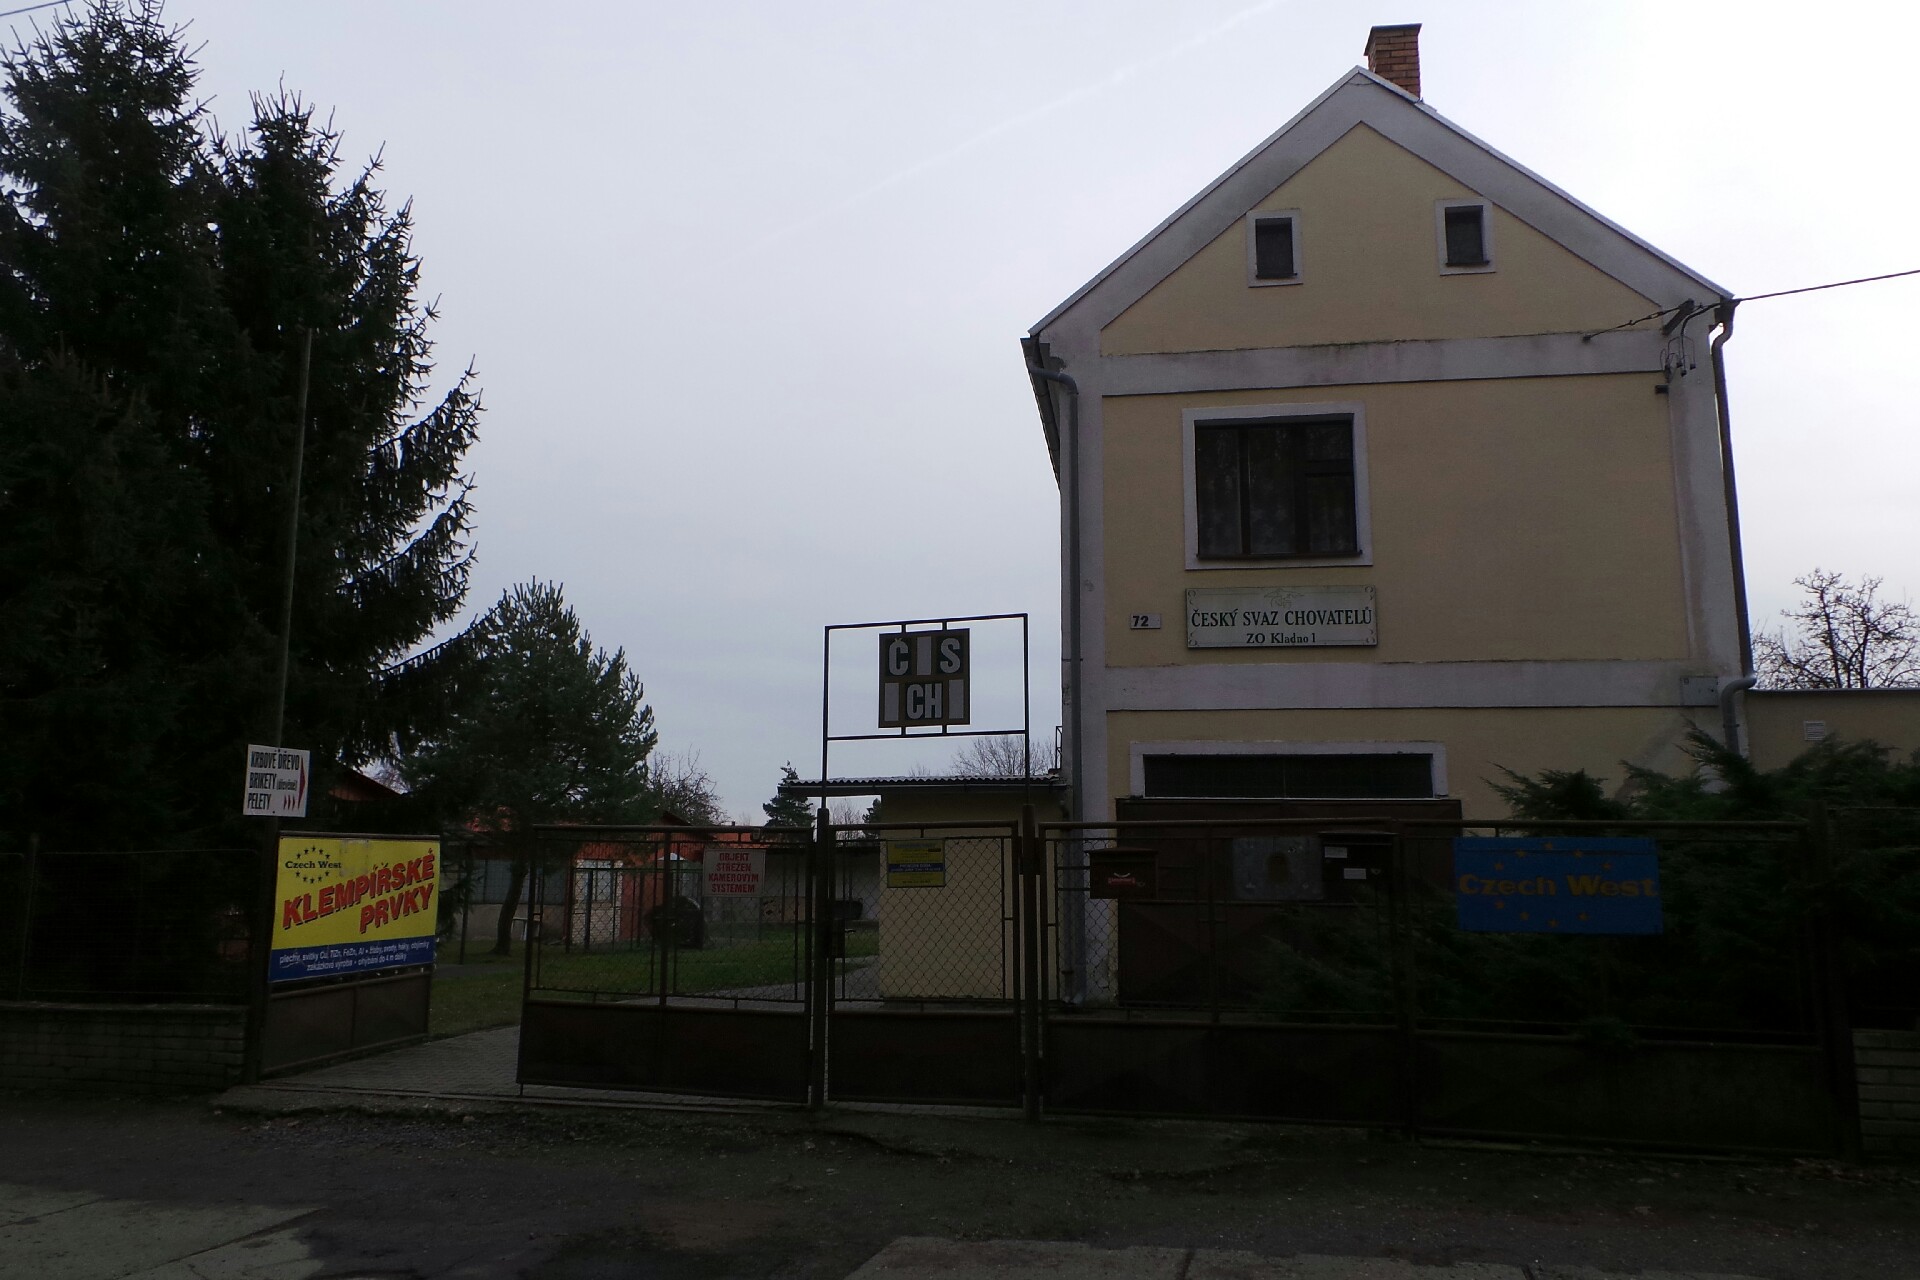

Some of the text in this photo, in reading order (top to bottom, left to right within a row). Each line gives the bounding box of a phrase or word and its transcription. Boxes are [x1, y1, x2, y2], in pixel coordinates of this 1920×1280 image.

[1133, 616, 1149, 628] 72
[1191, 606, 1372, 627] ČESKÝ SVAZ CHOVATELŮ
[1246, 633, 1266, 644] ZO
[1270, 633, 1309, 644] Kladno
[277, 751, 300, 771] DŘEVO
[249, 772, 277, 790] BRIKETY
[247, 793, 272, 810] PELETY
[285, 860, 342, 870] Czech West
[719, 852, 750, 862] OBJEKT
[282, 848, 435, 930] KLEMPÍŘSKÉ
[1458, 873, 1658, 897] Czech West
[359, 882, 434, 934] PRVKY
